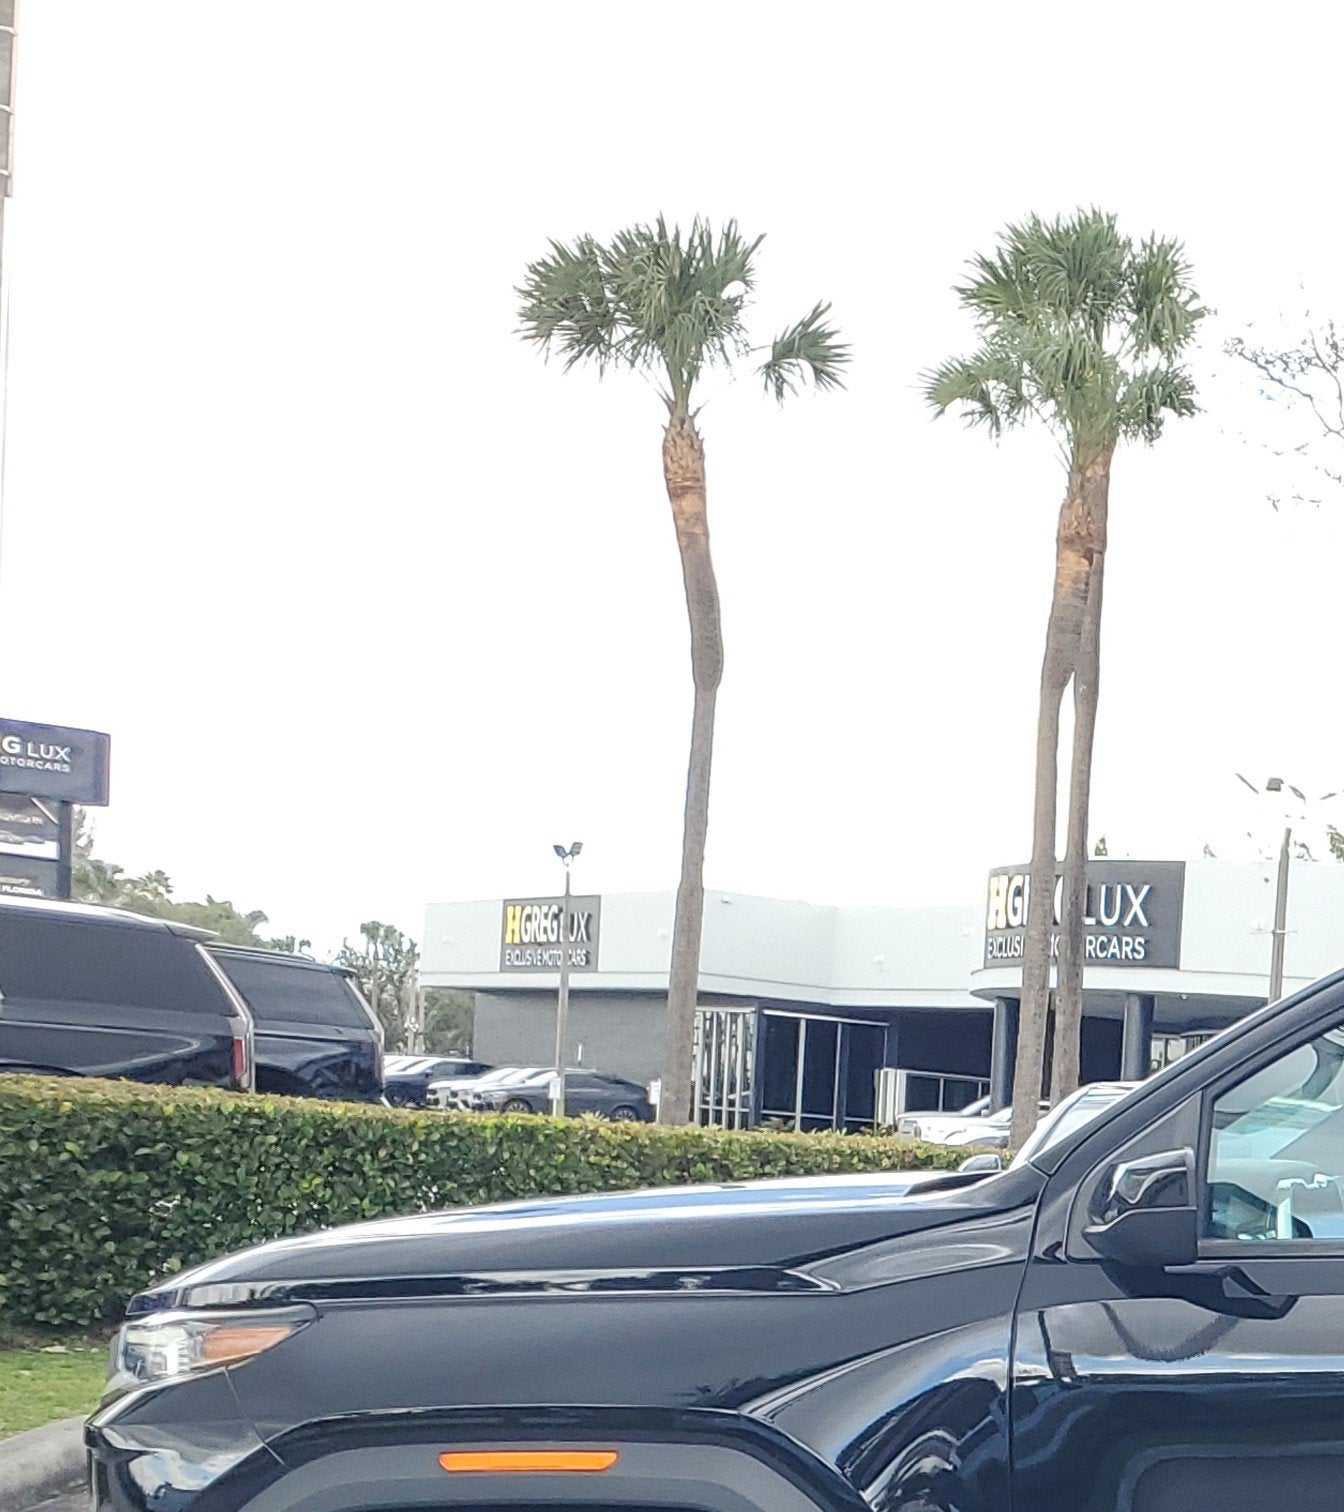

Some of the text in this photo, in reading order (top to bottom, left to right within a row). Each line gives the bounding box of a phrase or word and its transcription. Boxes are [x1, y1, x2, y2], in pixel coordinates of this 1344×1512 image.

[27, 741, 71, 762] LUX
[505, 904, 558, 944] HGREG
[987, 934, 1024, 959] EXCLUSI
